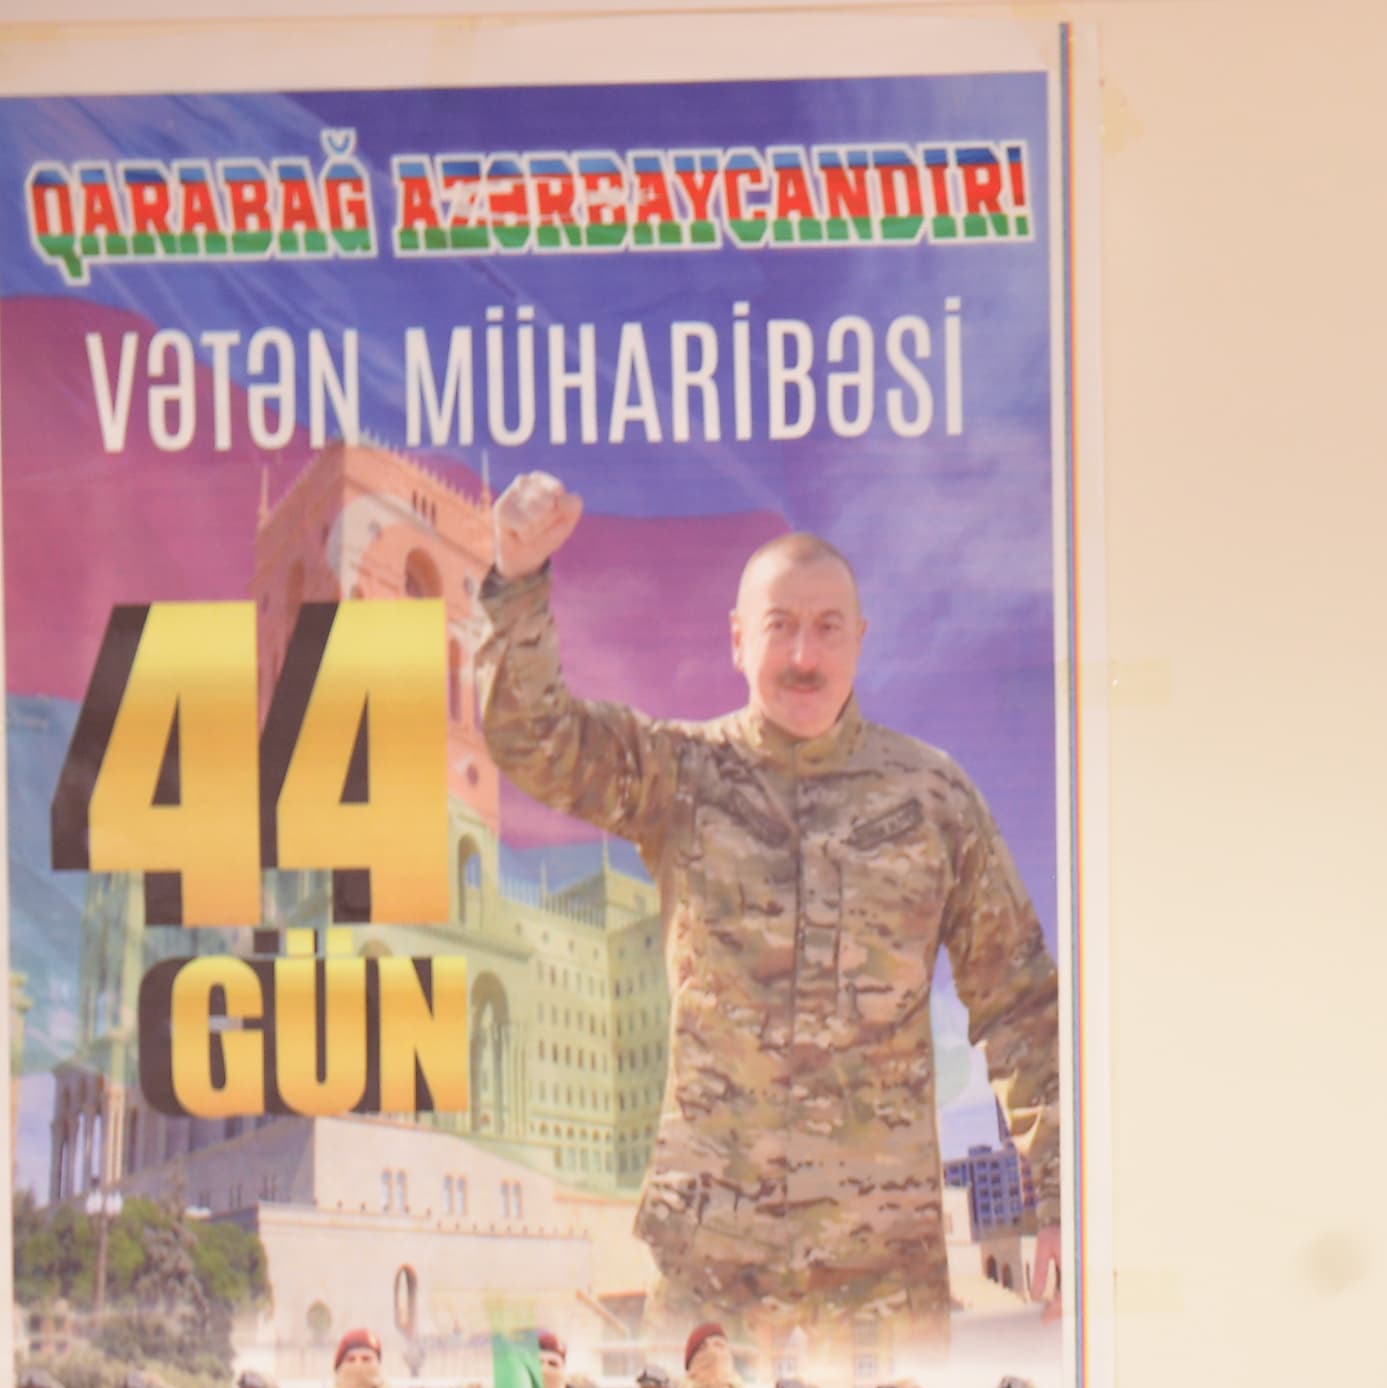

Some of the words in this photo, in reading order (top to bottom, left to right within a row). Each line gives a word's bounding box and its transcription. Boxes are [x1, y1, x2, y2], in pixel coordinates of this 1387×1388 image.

[24, 128, 378, 286] QARABAĞ
[391, 140, 1034, 257] AZƏRBAYCANDIR!
[86, 328, 360, 452] VƏTƏN
[404, 296, 963, 448] MÜHARİBƏSİ
[52, 600, 450, 926] 44
[138, 928, 470, 1118] GÜN
